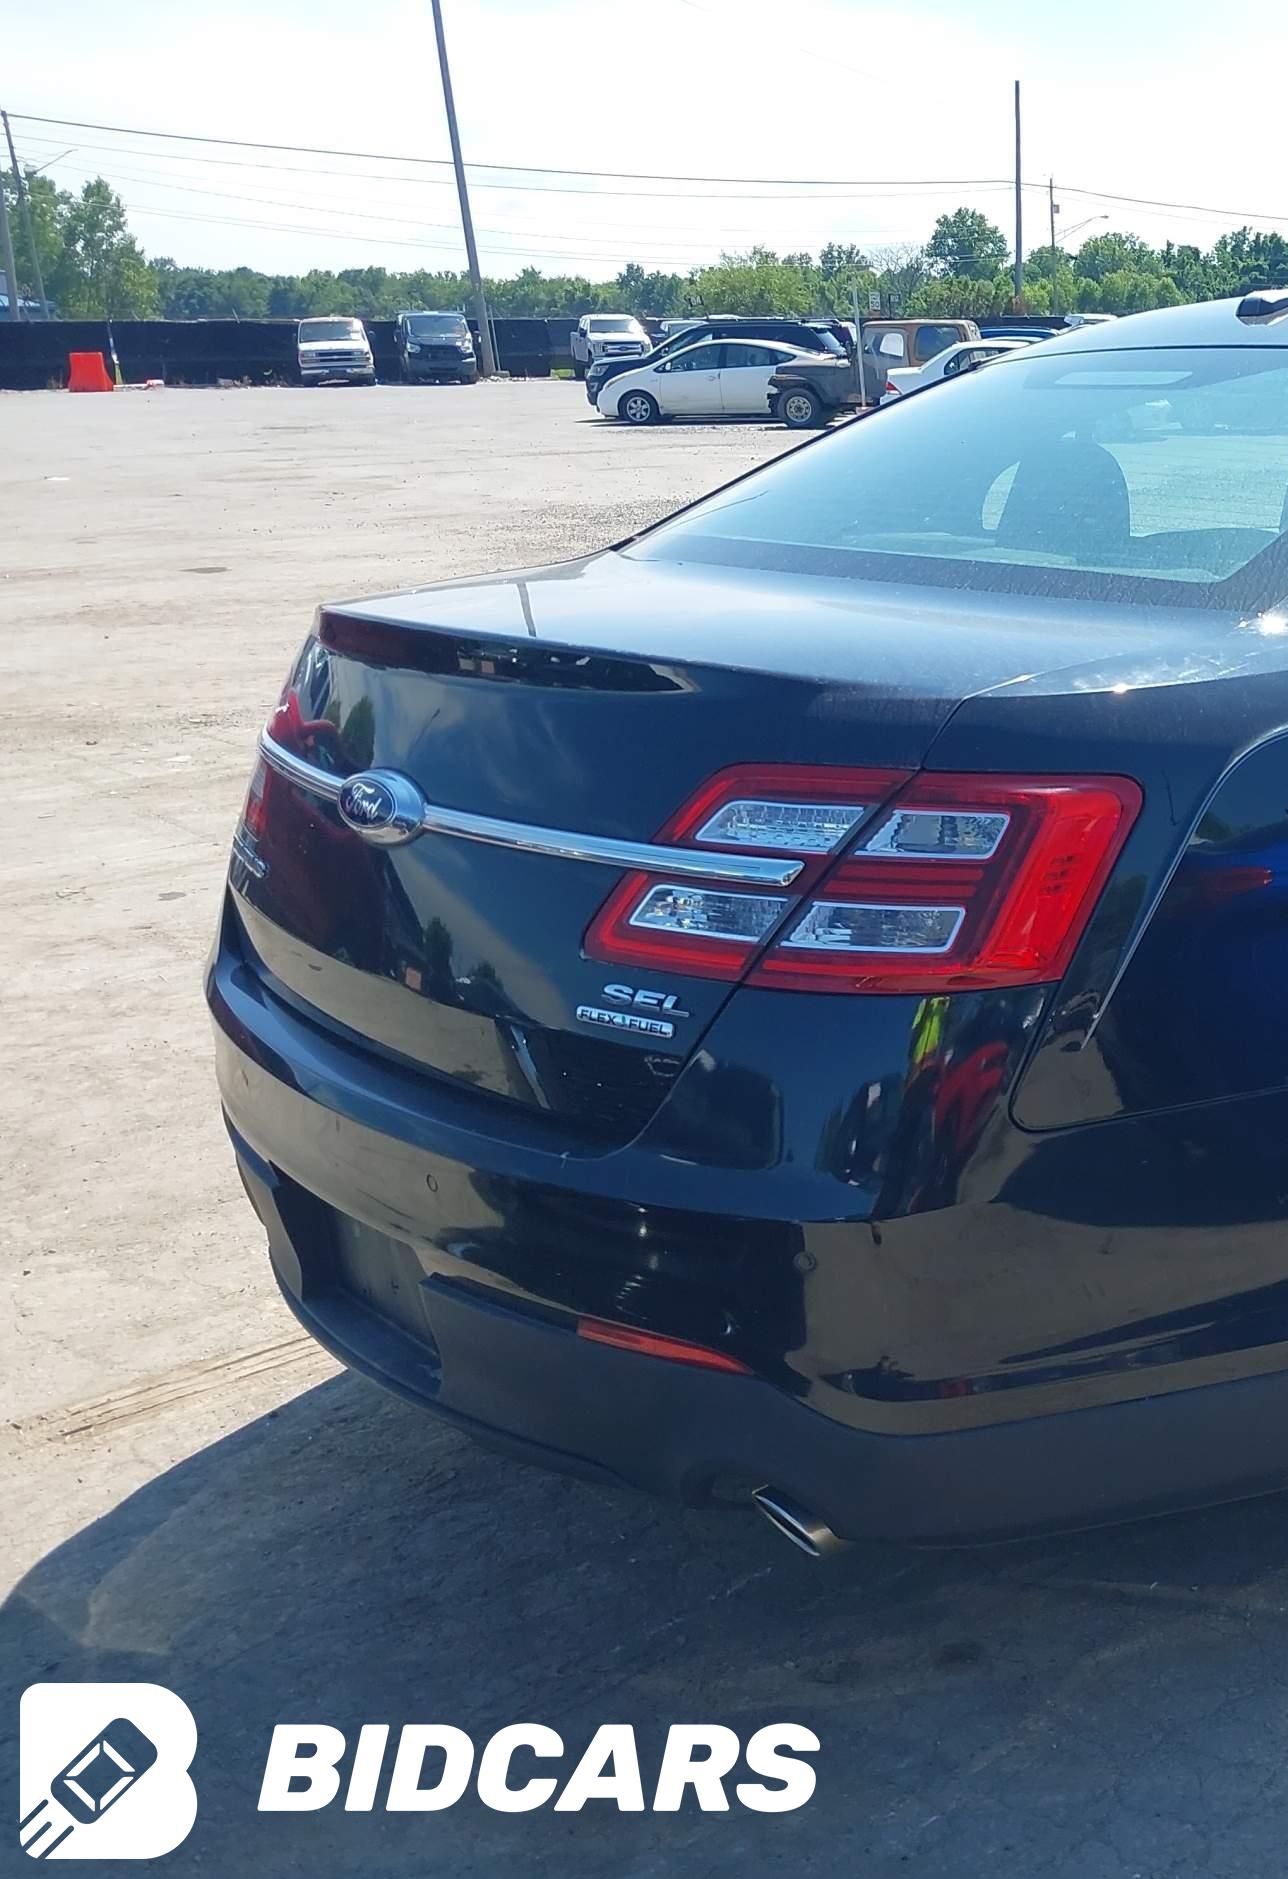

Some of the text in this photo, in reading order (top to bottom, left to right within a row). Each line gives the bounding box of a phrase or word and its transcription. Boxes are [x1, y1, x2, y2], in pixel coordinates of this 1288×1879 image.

[344, 783, 383, 820] Ford
[601, 983, 689, 1018] SEL
[579, 1009, 670, 1035] FLEX FUEL
